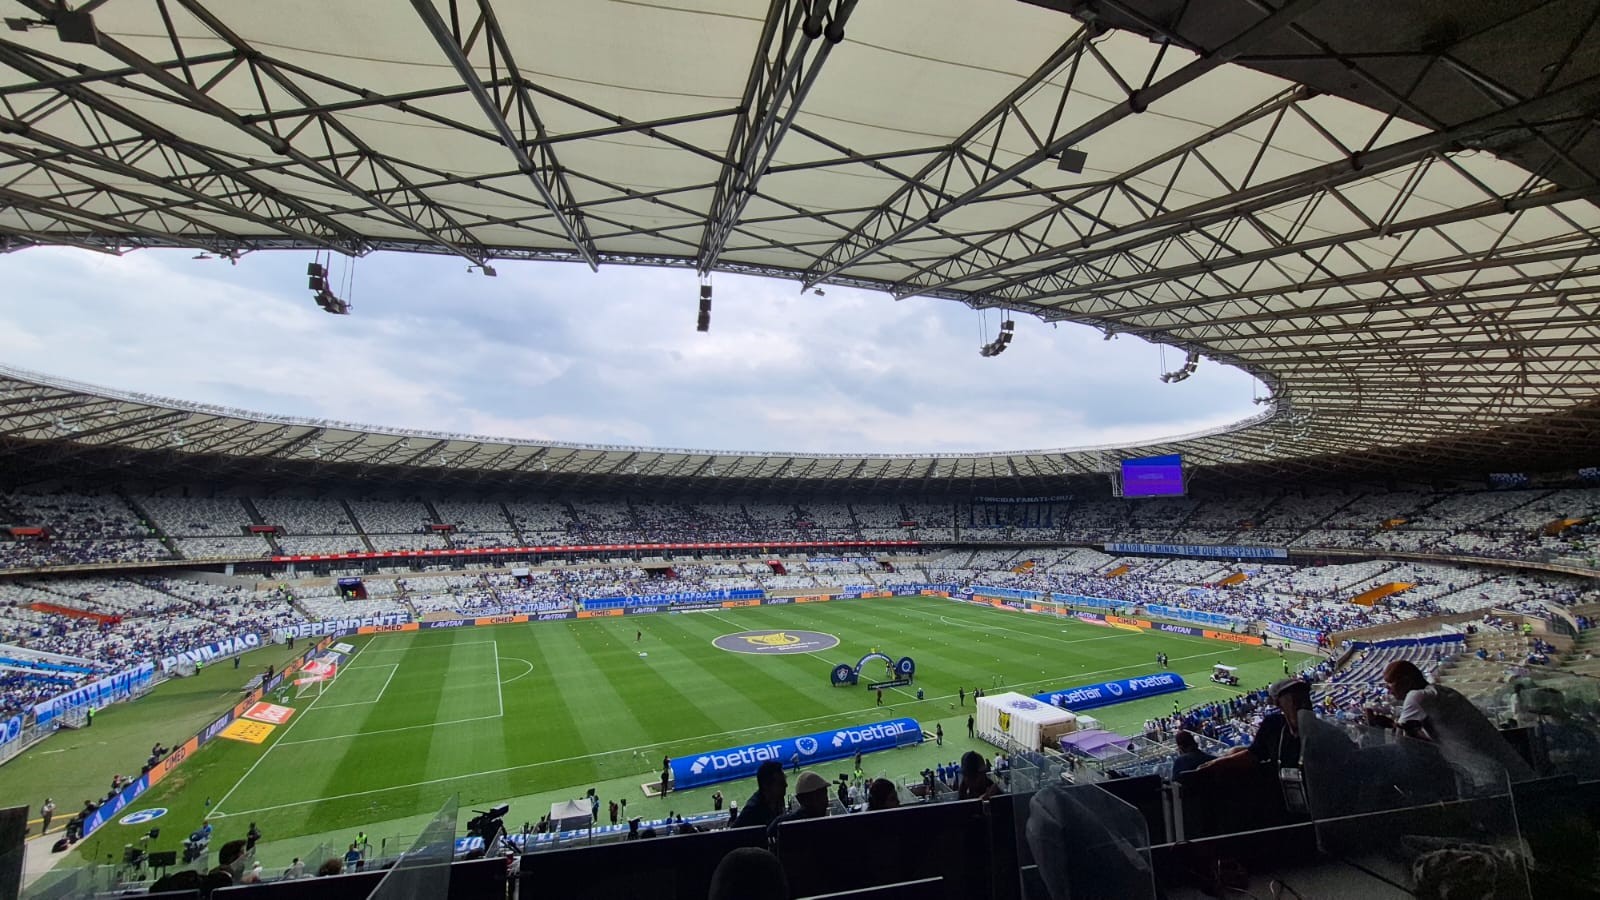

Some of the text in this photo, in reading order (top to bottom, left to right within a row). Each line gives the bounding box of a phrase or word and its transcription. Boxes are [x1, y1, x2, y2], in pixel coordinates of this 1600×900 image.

[1119, 543, 1141, 553] MAIOR
[1143, 544, 1154, 553] DE
[1156, 545, 1180, 554] MINAS
[1183, 546, 1200, 556] TEM
[1202, 546, 1219, 556] QUE
[639, 595, 662, 603] TOCA
[680, 591, 713, 601] RAPOSA
[527, 601, 558, 613] ITABIRA
[632, 607, 658, 615] LAVITAN
[490, 616, 515, 625] CIMED
[538, 613, 568, 621] LAVITAN
[1074, 610, 1097, 620] LAVITAN
[271, 614, 409, 642] INDEPENDENTE
[375, 624, 402, 632] CIMED
[430, 619, 464, 629] LAVITAN
[1116, 617, 1138, 627] CIMED
[1160, 623, 1192, 636] LAVITAN
[1139, 673, 1174, 689] betfair
[849, 719, 907, 744] betfair
[164, 746, 186, 772] CIMED
[711, 743, 783, 771] betfair
